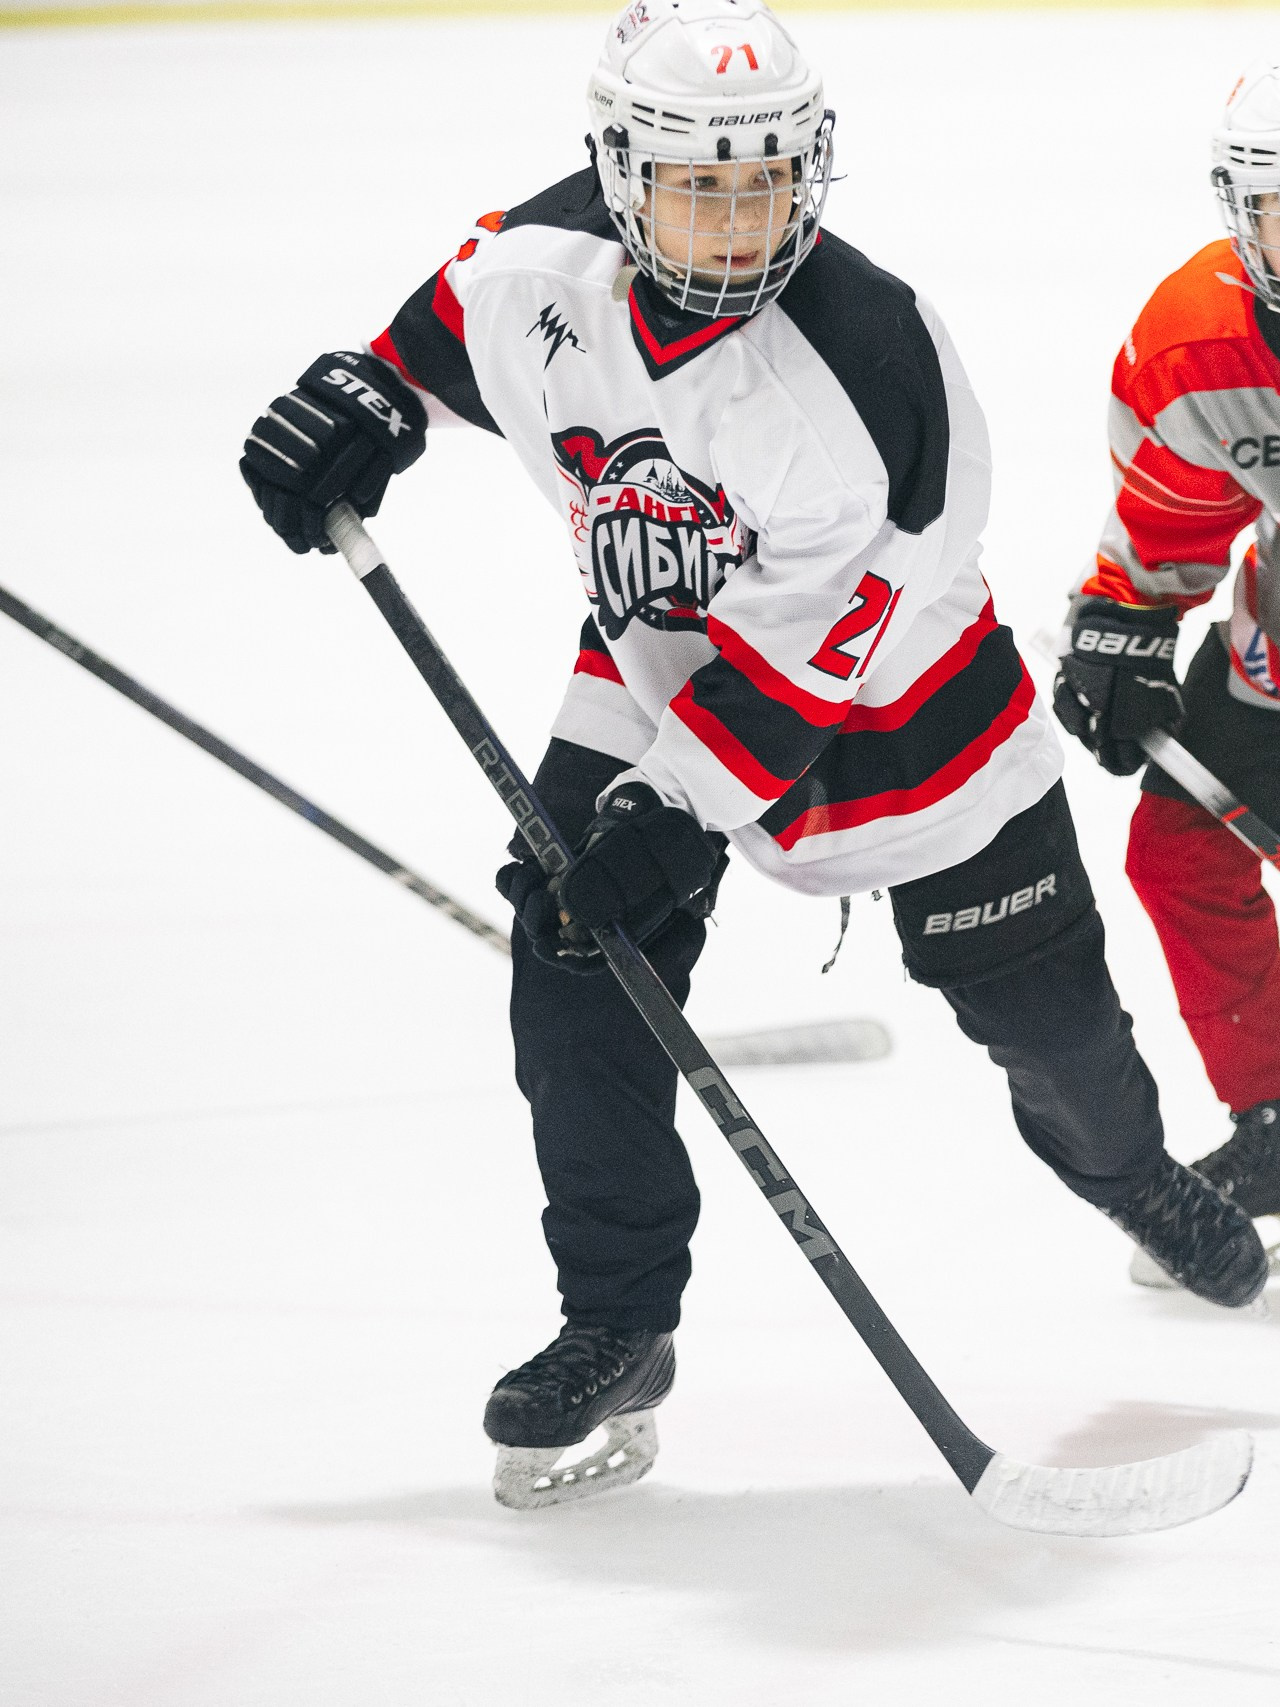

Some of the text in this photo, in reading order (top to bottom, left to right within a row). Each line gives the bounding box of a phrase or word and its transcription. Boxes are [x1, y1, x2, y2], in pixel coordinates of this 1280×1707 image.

[708, 110, 783, 127] BAUER
[321, 368, 411, 438] STEX
[1075, 629, 1177, 660] BAUE
[473, 737, 569, 875] RIBCO
[923, 872, 1058, 936] BAUER
[686, 1065, 840, 1262] CCM
